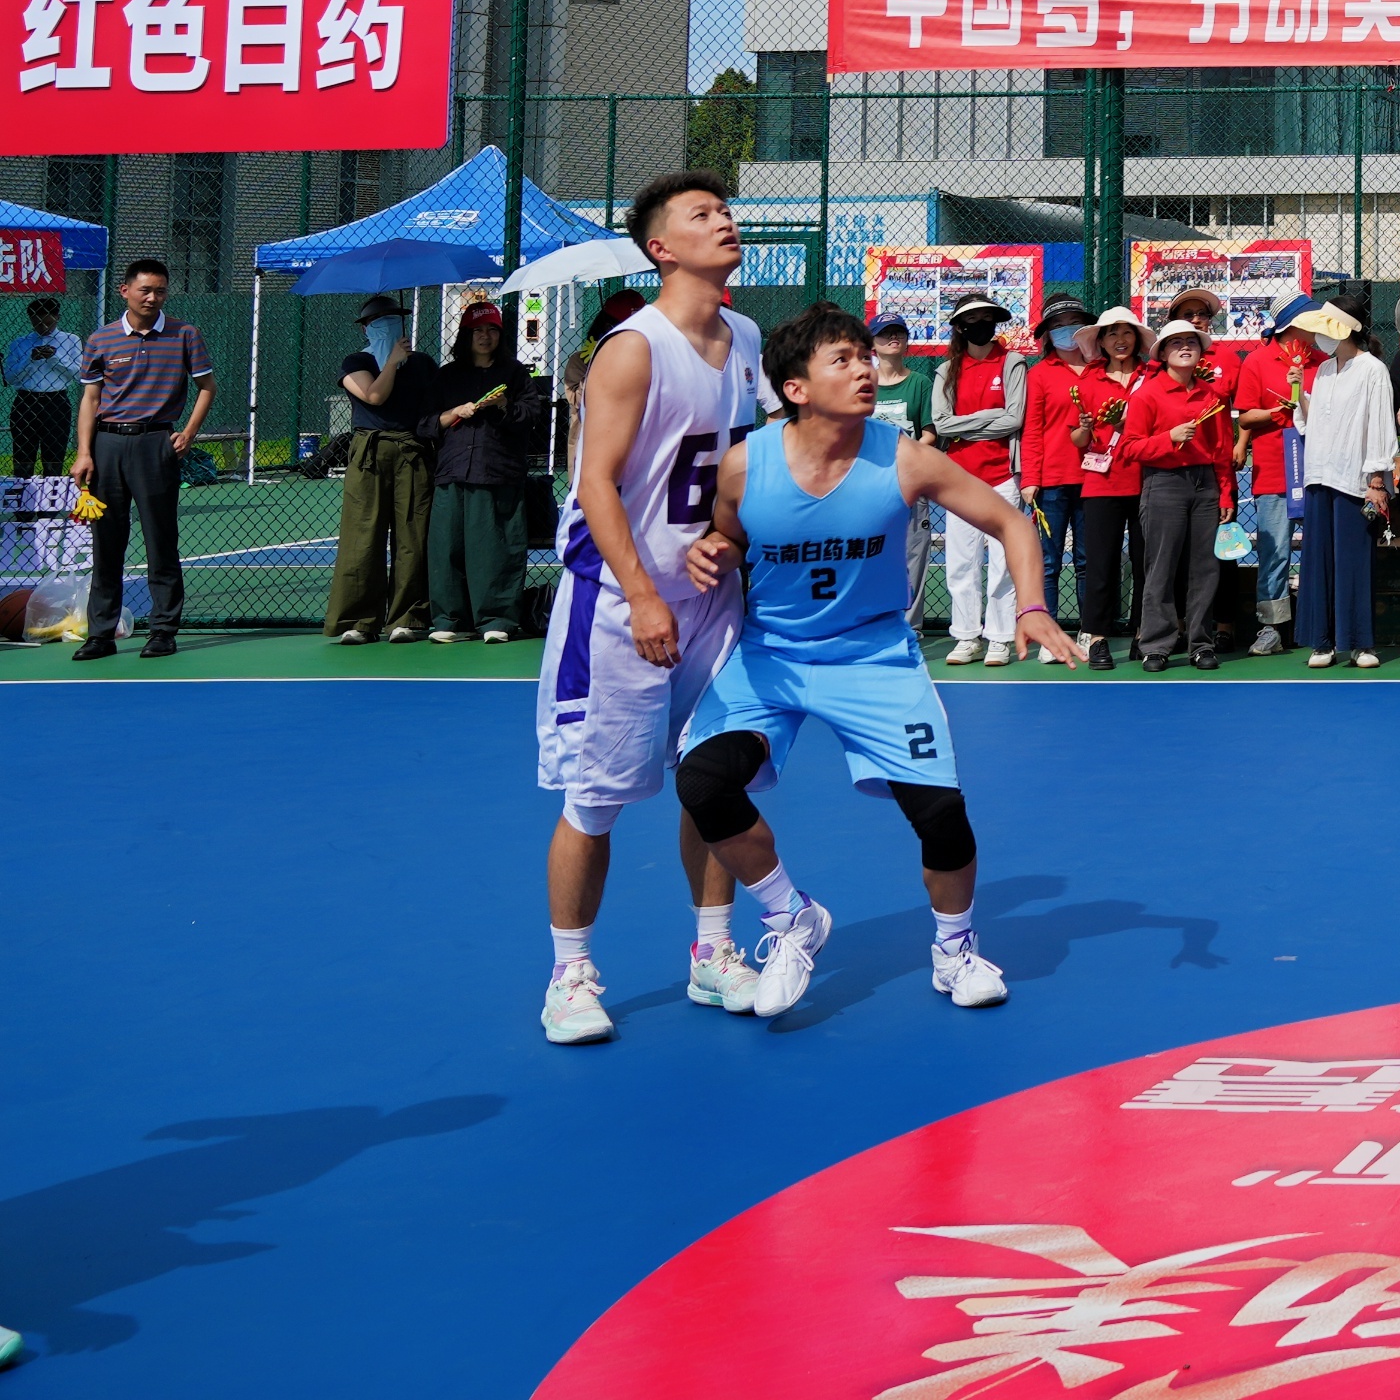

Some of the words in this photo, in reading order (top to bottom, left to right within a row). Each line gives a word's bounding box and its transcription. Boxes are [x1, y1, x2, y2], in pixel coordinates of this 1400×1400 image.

[761, 534, 886, 566] 云南白药集团
[810, 567, 837, 600] 2
[904, 722, 938, 760] 2
